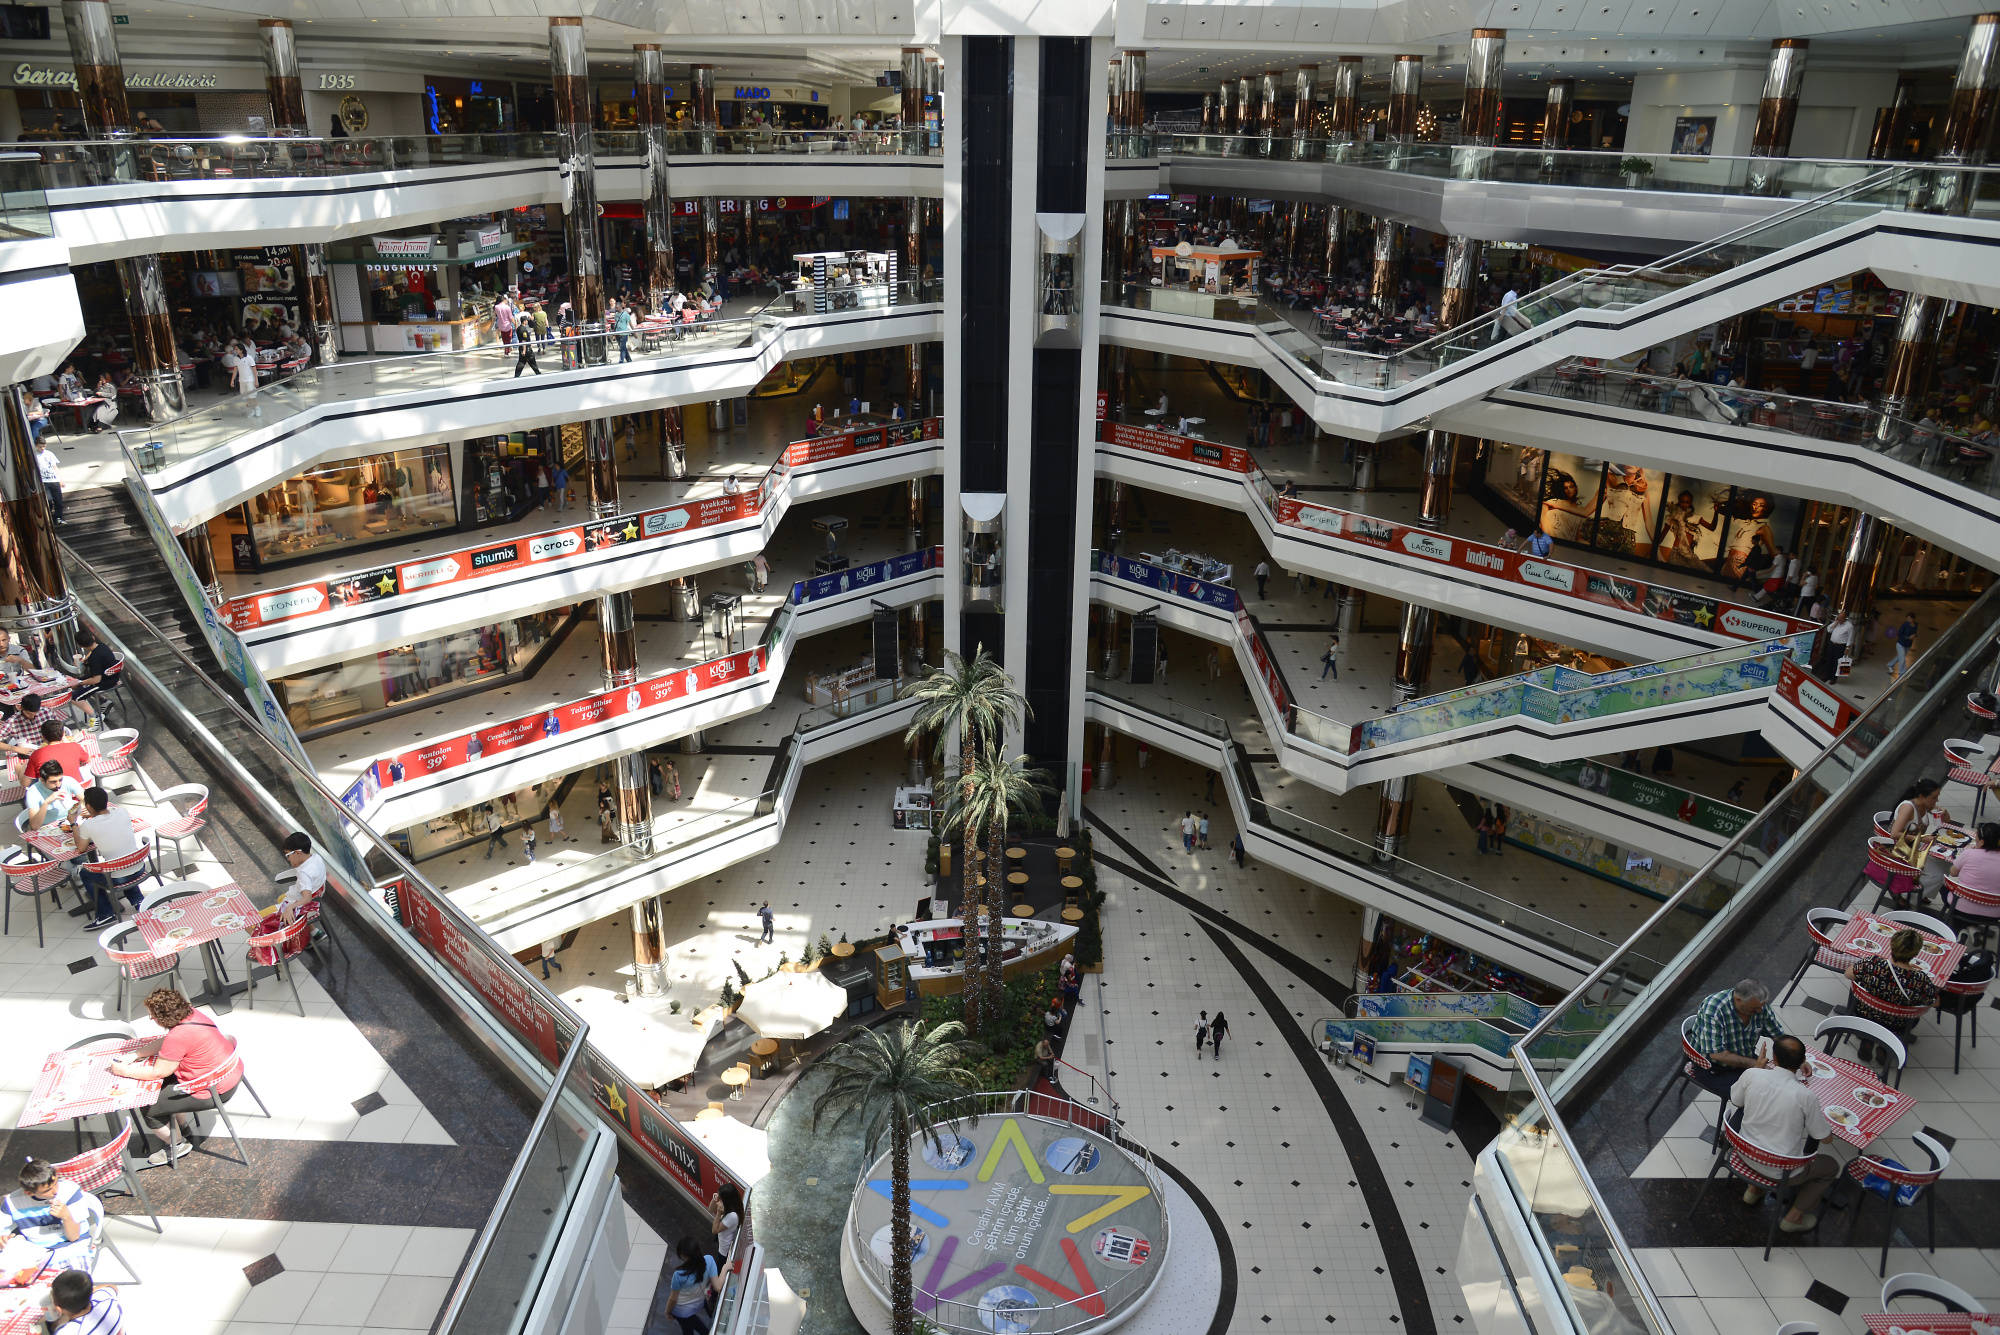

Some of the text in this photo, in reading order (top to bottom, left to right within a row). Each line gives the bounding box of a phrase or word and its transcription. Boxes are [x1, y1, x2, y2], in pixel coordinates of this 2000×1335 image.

[124, 73, 217, 88] hallebicisi
[319, 74, 355, 89] 1935
[735, 87, 771, 99] MADO
[685, 200, 735, 213] BER
[367, 264, 438, 272] DOUGHNUTS
[855, 434, 880, 446] shumix
[700, 499, 730, 510] Ayakkabı
[700, 505, 736, 517] shumix'ten
[543, 538, 575, 551] crocs
[1411, 543, 1443, 556] LACOSTE
[475, 549, 514, 566] shumix
[1466, 548, 1504, 571] indirim
[405, 568, 444, 581] MERRELL
[1590, 579, 1632, 599] shumix
[263, 595, 318, 613] STONEFLY
[1740, 620, 1782, 636] SUPERGA
[1743, 664, 1765, 678] Selin
[650, 679, 674, 691] Gömlek
[570, 698, 613, 715] Takım Elbise
[1800, 688, 1836, 717] SALOMON
[418, 746, 452, 761] Pantolon
[1632, 781, 1667, 797] Gömlek
[643, 1114, 696, 1174] shumix
[659, 1151, 668, 1164] on
[669, 1160, 682, 1177] this
[967, 1182, 1007, 1246] Cevahir AVM
[1002, 1196, 1032, 1245] tüm şehir
[985, 1217, 1006, 1251] şehrin
[1015, 1232, 1034, 1259] onun
